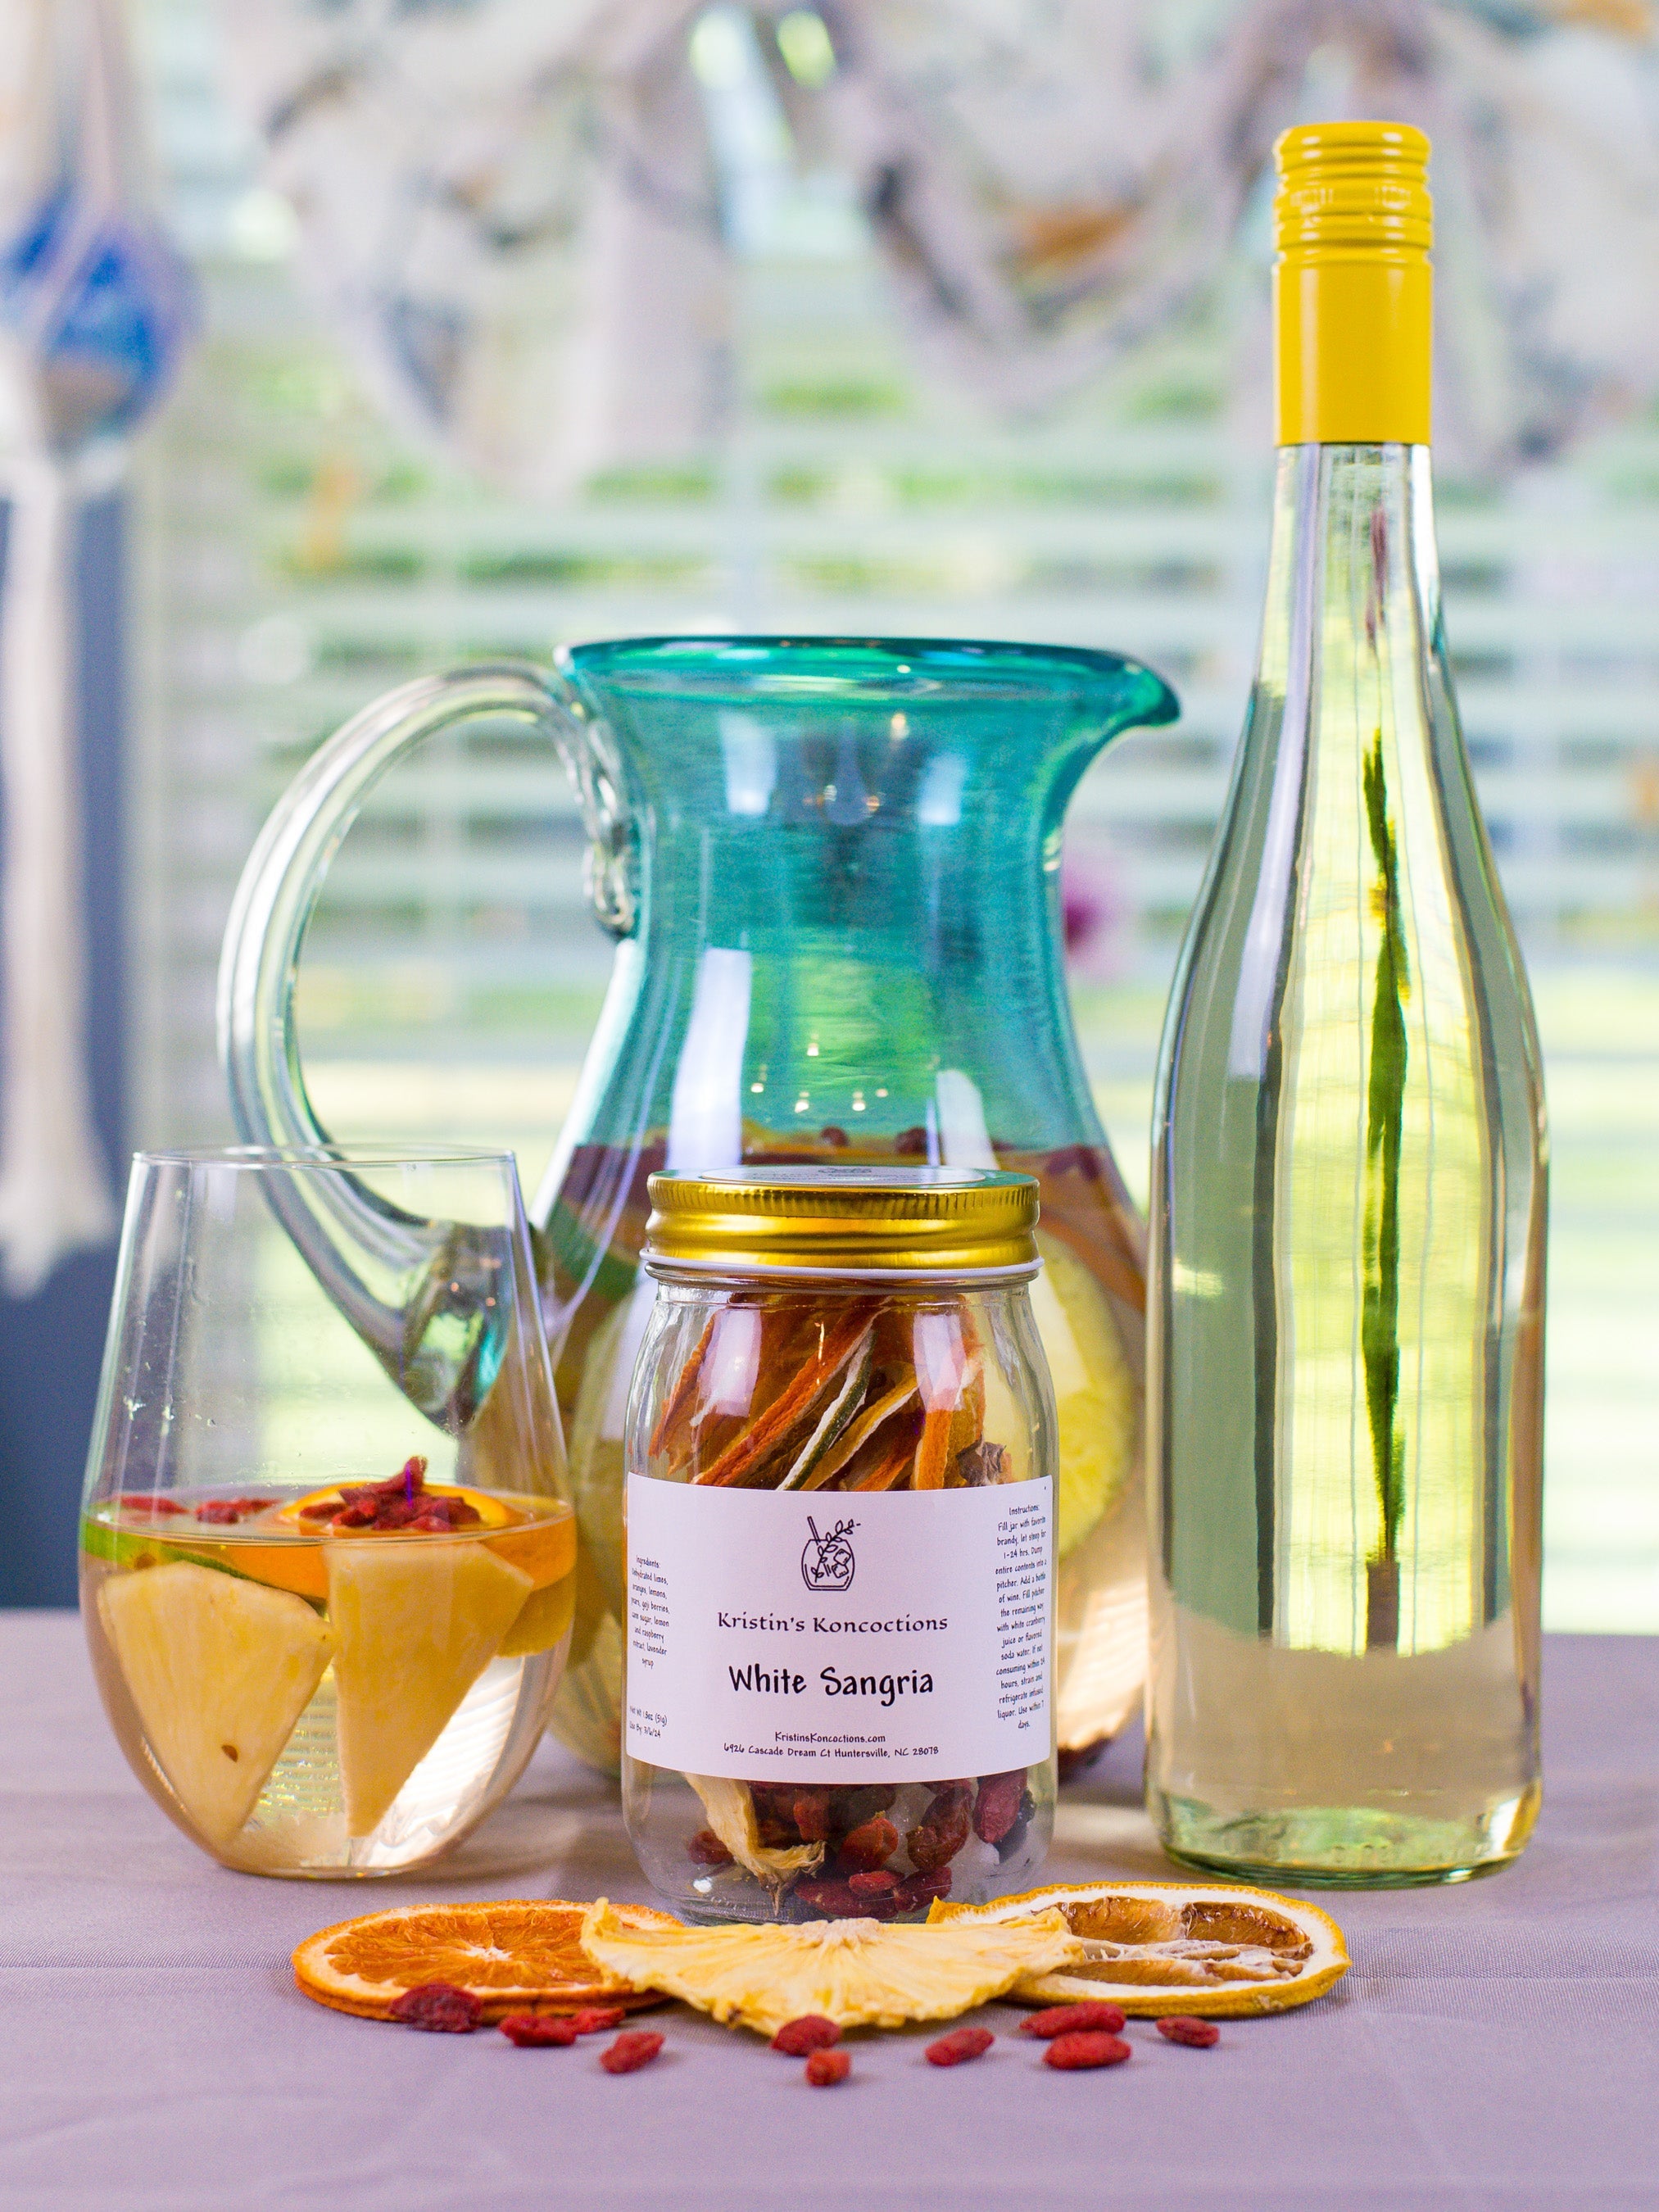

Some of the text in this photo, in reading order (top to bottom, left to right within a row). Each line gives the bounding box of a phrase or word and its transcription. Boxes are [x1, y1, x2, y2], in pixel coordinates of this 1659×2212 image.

[998, 1521, 1008, 1531] Fill
[1009, 1521, 1018, 1532] jar
[1020, 1518, 1030, 1528] with
[995, 1566, 1013, 1575] entire
[1015, 1562, 1036, 1571] contents
[1020, 1575, 1030, 1585] Add
[999, 1593, 1005, 1603] of
[1000, 1608, 1009, 1617] the
[1012, 1604, 1036, 1616] remaining
[654, 1616, 669, 1627] lemon
[717, 1611, 948, 1633] Kristin's Koncoctions
[997, 1622, 1009, 1632] with
[1011, 1620, 1024, 1630] white
[1001, 1637, 1016, 1648] juice
[1001, 1650, 1014, 1661] soda
[996, 1664, 1026, 1675] consuming
[728, 1663, 933, 1707] White Sangria
[1021, 1676, 1034, 1685] strain
[999, 1691, 1027, 1705] refrigerate
[1018, 1706, 1027, 1715] Use
[775, 1731, 886, 1743] KristinsKoncoctions.com
[723, 1743, 939, 1758] 6926 Cascade Dream Ct Huntersville, NC 28078
